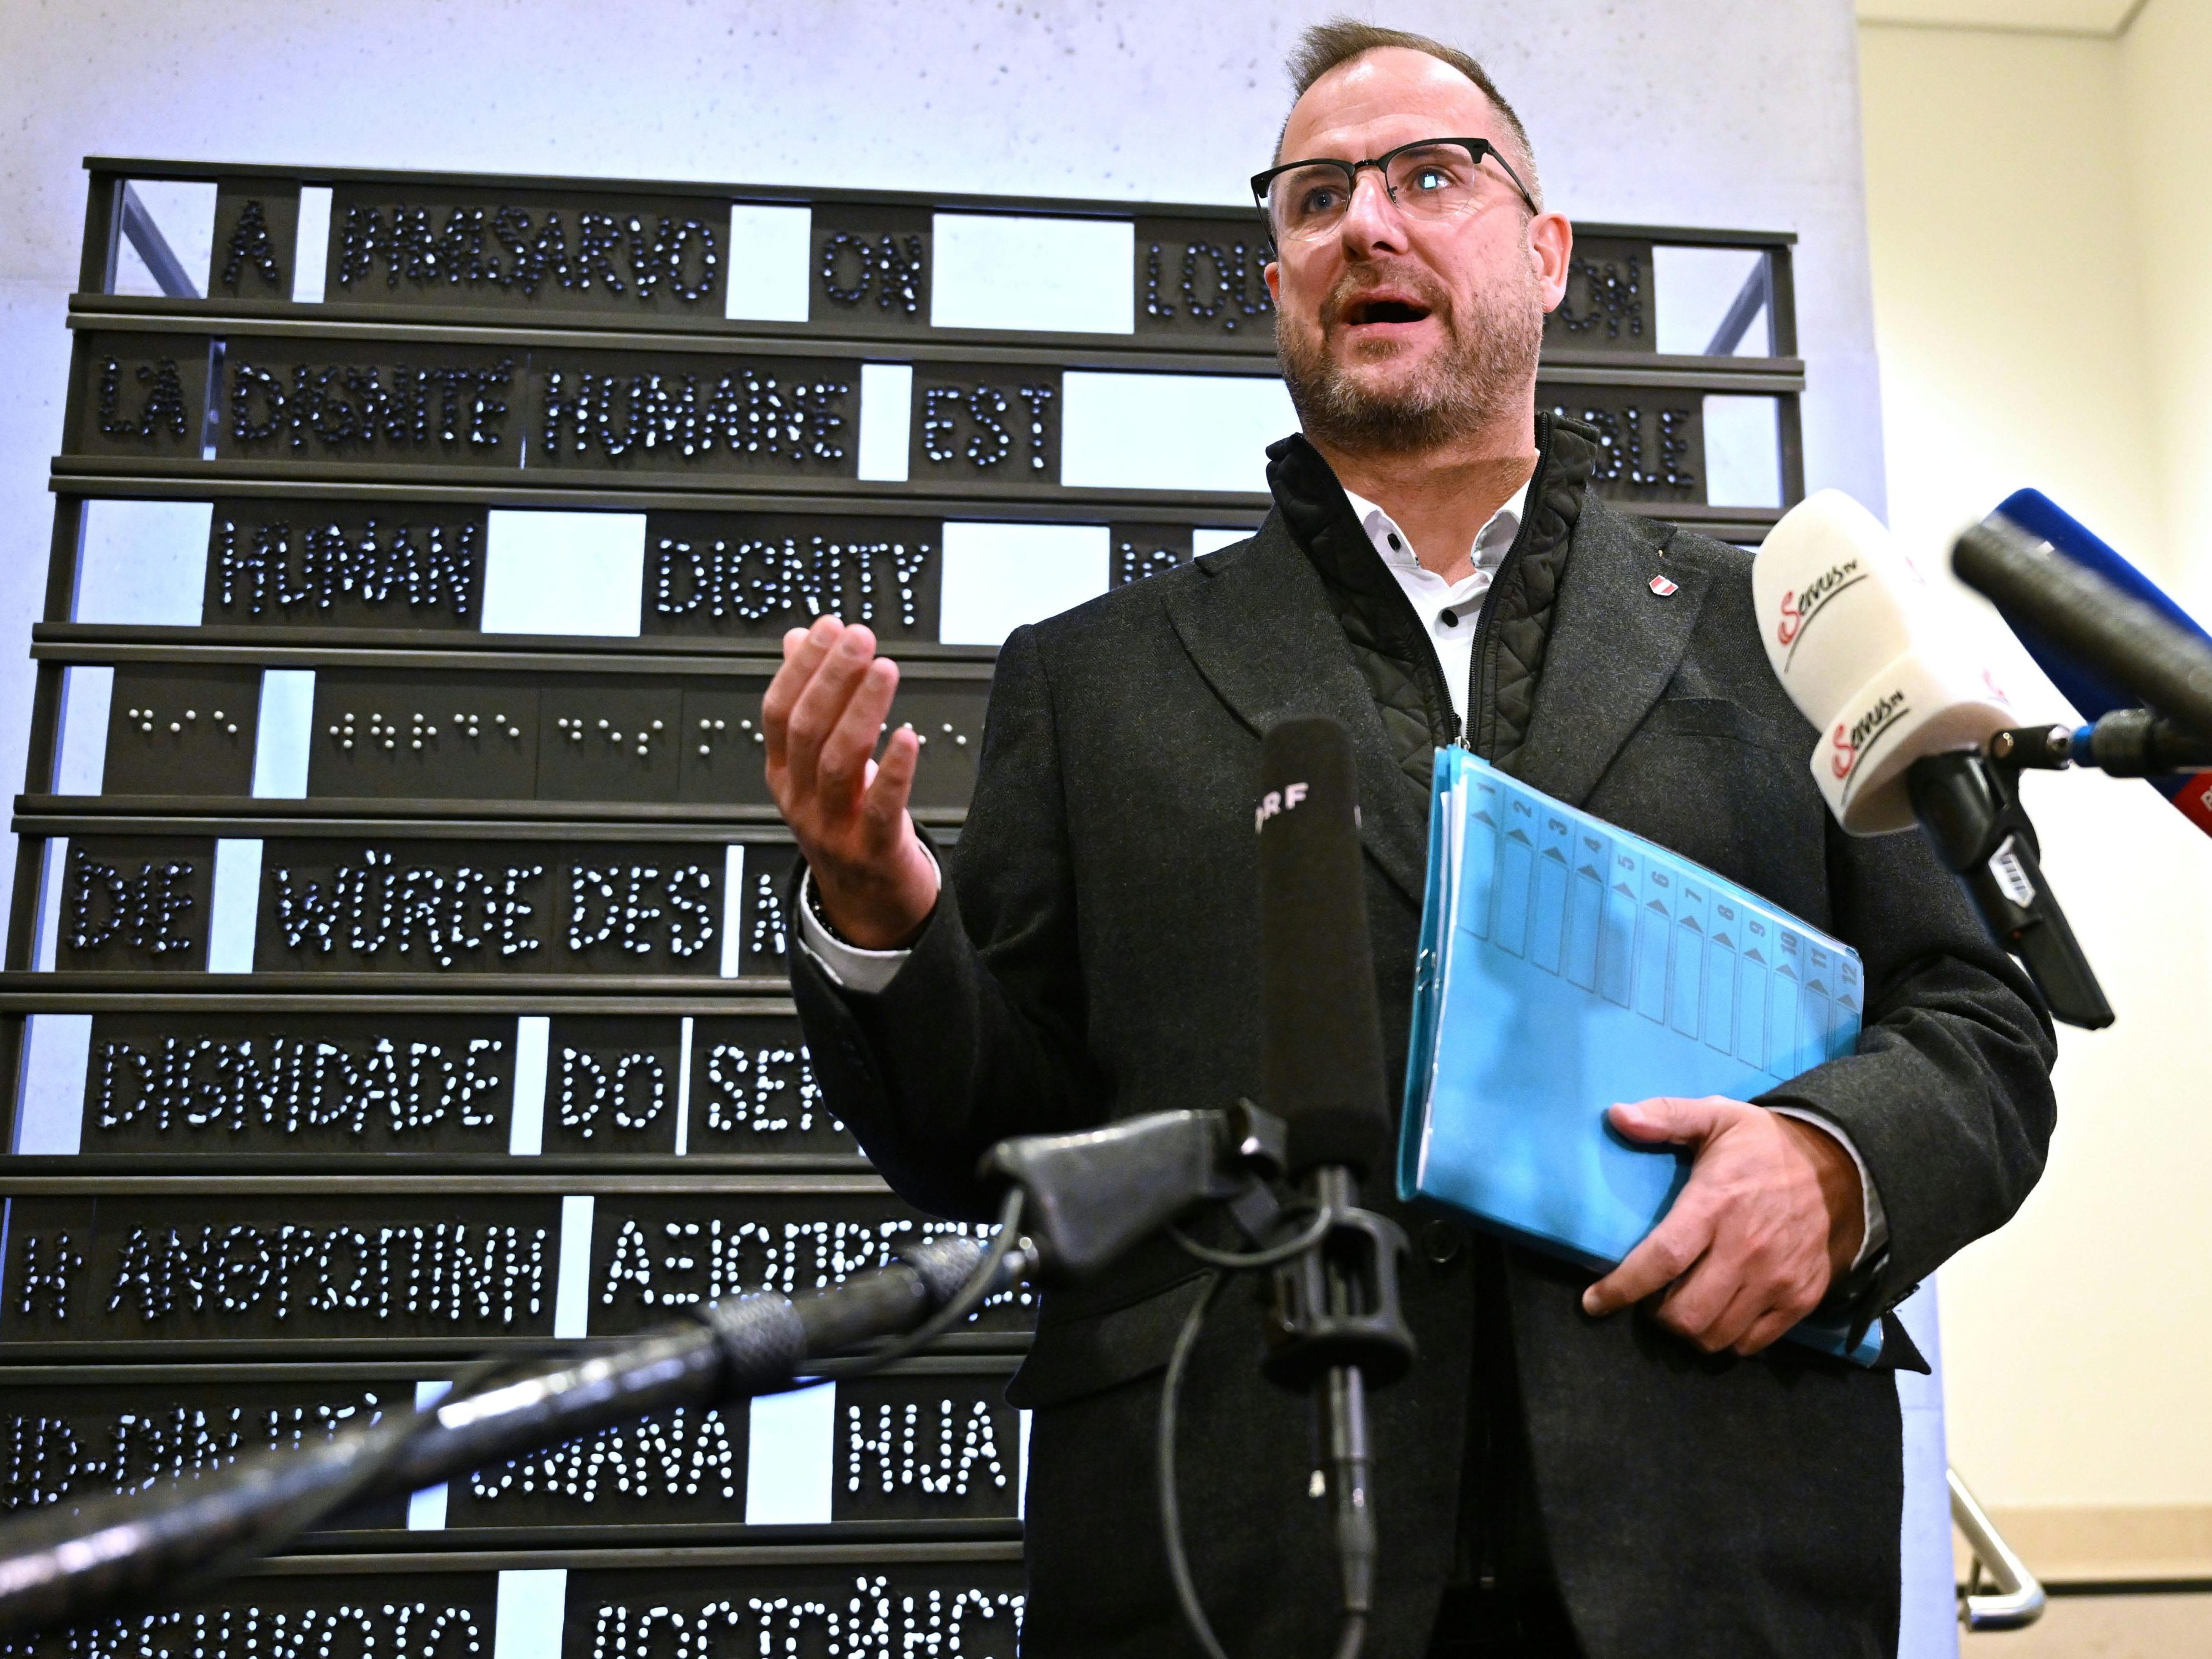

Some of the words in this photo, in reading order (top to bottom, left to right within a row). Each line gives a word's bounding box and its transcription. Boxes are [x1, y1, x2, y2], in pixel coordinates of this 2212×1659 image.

[823, 232, 922, 313] ON
[924, 385, 1052, 470] EST
[223, 519, 476, 613] HUMAN
[659, 536, 930, 625] DIGNITY
[72, 849, 193, 950] DIE
[274, 849, 542, 965] WÜRDE
[570, 866, 713, 956] DES
[1513, 800, 1532, 818] 2
[1548, 817, 1567, 836] 3
[1583, 835, 1602, 853] 4
[1618, 854, 1634, 871] 5
[1651, 871, 1669, 888] 6
[1685, 888, 1702, 903] 7
[1717, 904, 1735, 921] 8
[1749, 919, 1766, 937] 9
[1781, 930, 1797, 956] 10
[1811, 947, 1827, 969] 11
[1842, 961, 1857, 985] 12
[98, 1036, 502, 1131] DIGNIDADE
[562, 1047, 664, 1138] DO
[848, 1400, 1006, 1494] HIJA
